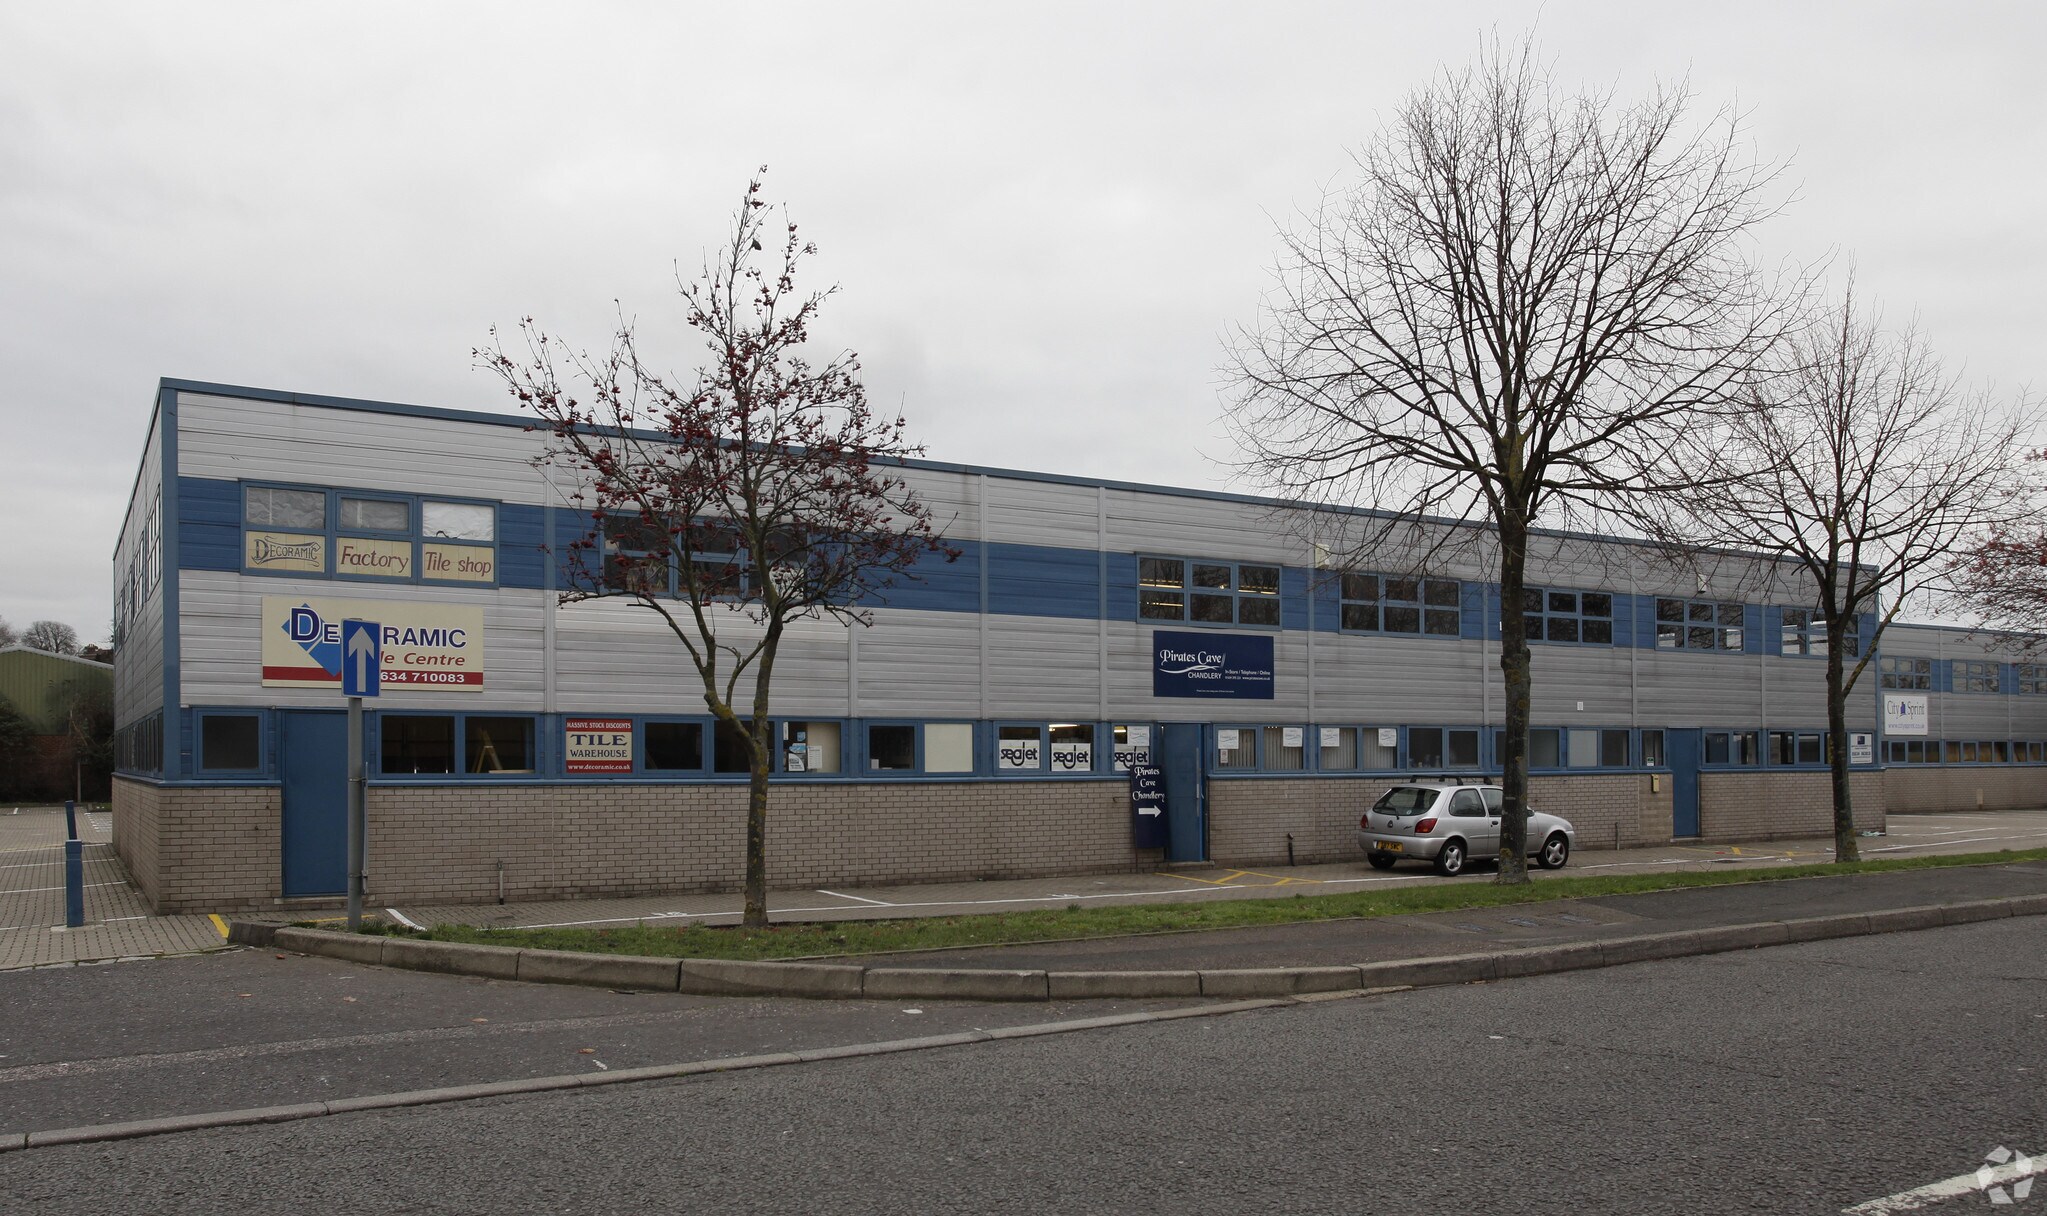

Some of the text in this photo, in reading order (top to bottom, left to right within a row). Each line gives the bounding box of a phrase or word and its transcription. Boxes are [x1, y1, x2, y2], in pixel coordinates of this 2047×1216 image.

[341, 545, 409, 573] Factory
[425, 551, 491, 577] Tile shop
[290, 607, 467, 648] DERAMIC
[404, 652, 465, 666] Centre
[1159, 649, 1222, 666] Pirates Cave
[380, 671, 465, 683] 634 710083
[1188, 671, 1222, 679] CHANDLERY
[1887, 700, 1925, 719] City Sprint
[570, 734, 628, 746] TILE
[570, 749, 628, 758] WAREHOUSE
[1000, 742, 1038, 767] seajet
[1053, 745, 1089, 769] seajet
[1134, 766, 1160, 779] Pirates
[1140, 778, 1156, 788] Cave
[1132, 791, 1165, 802] Chandlery
